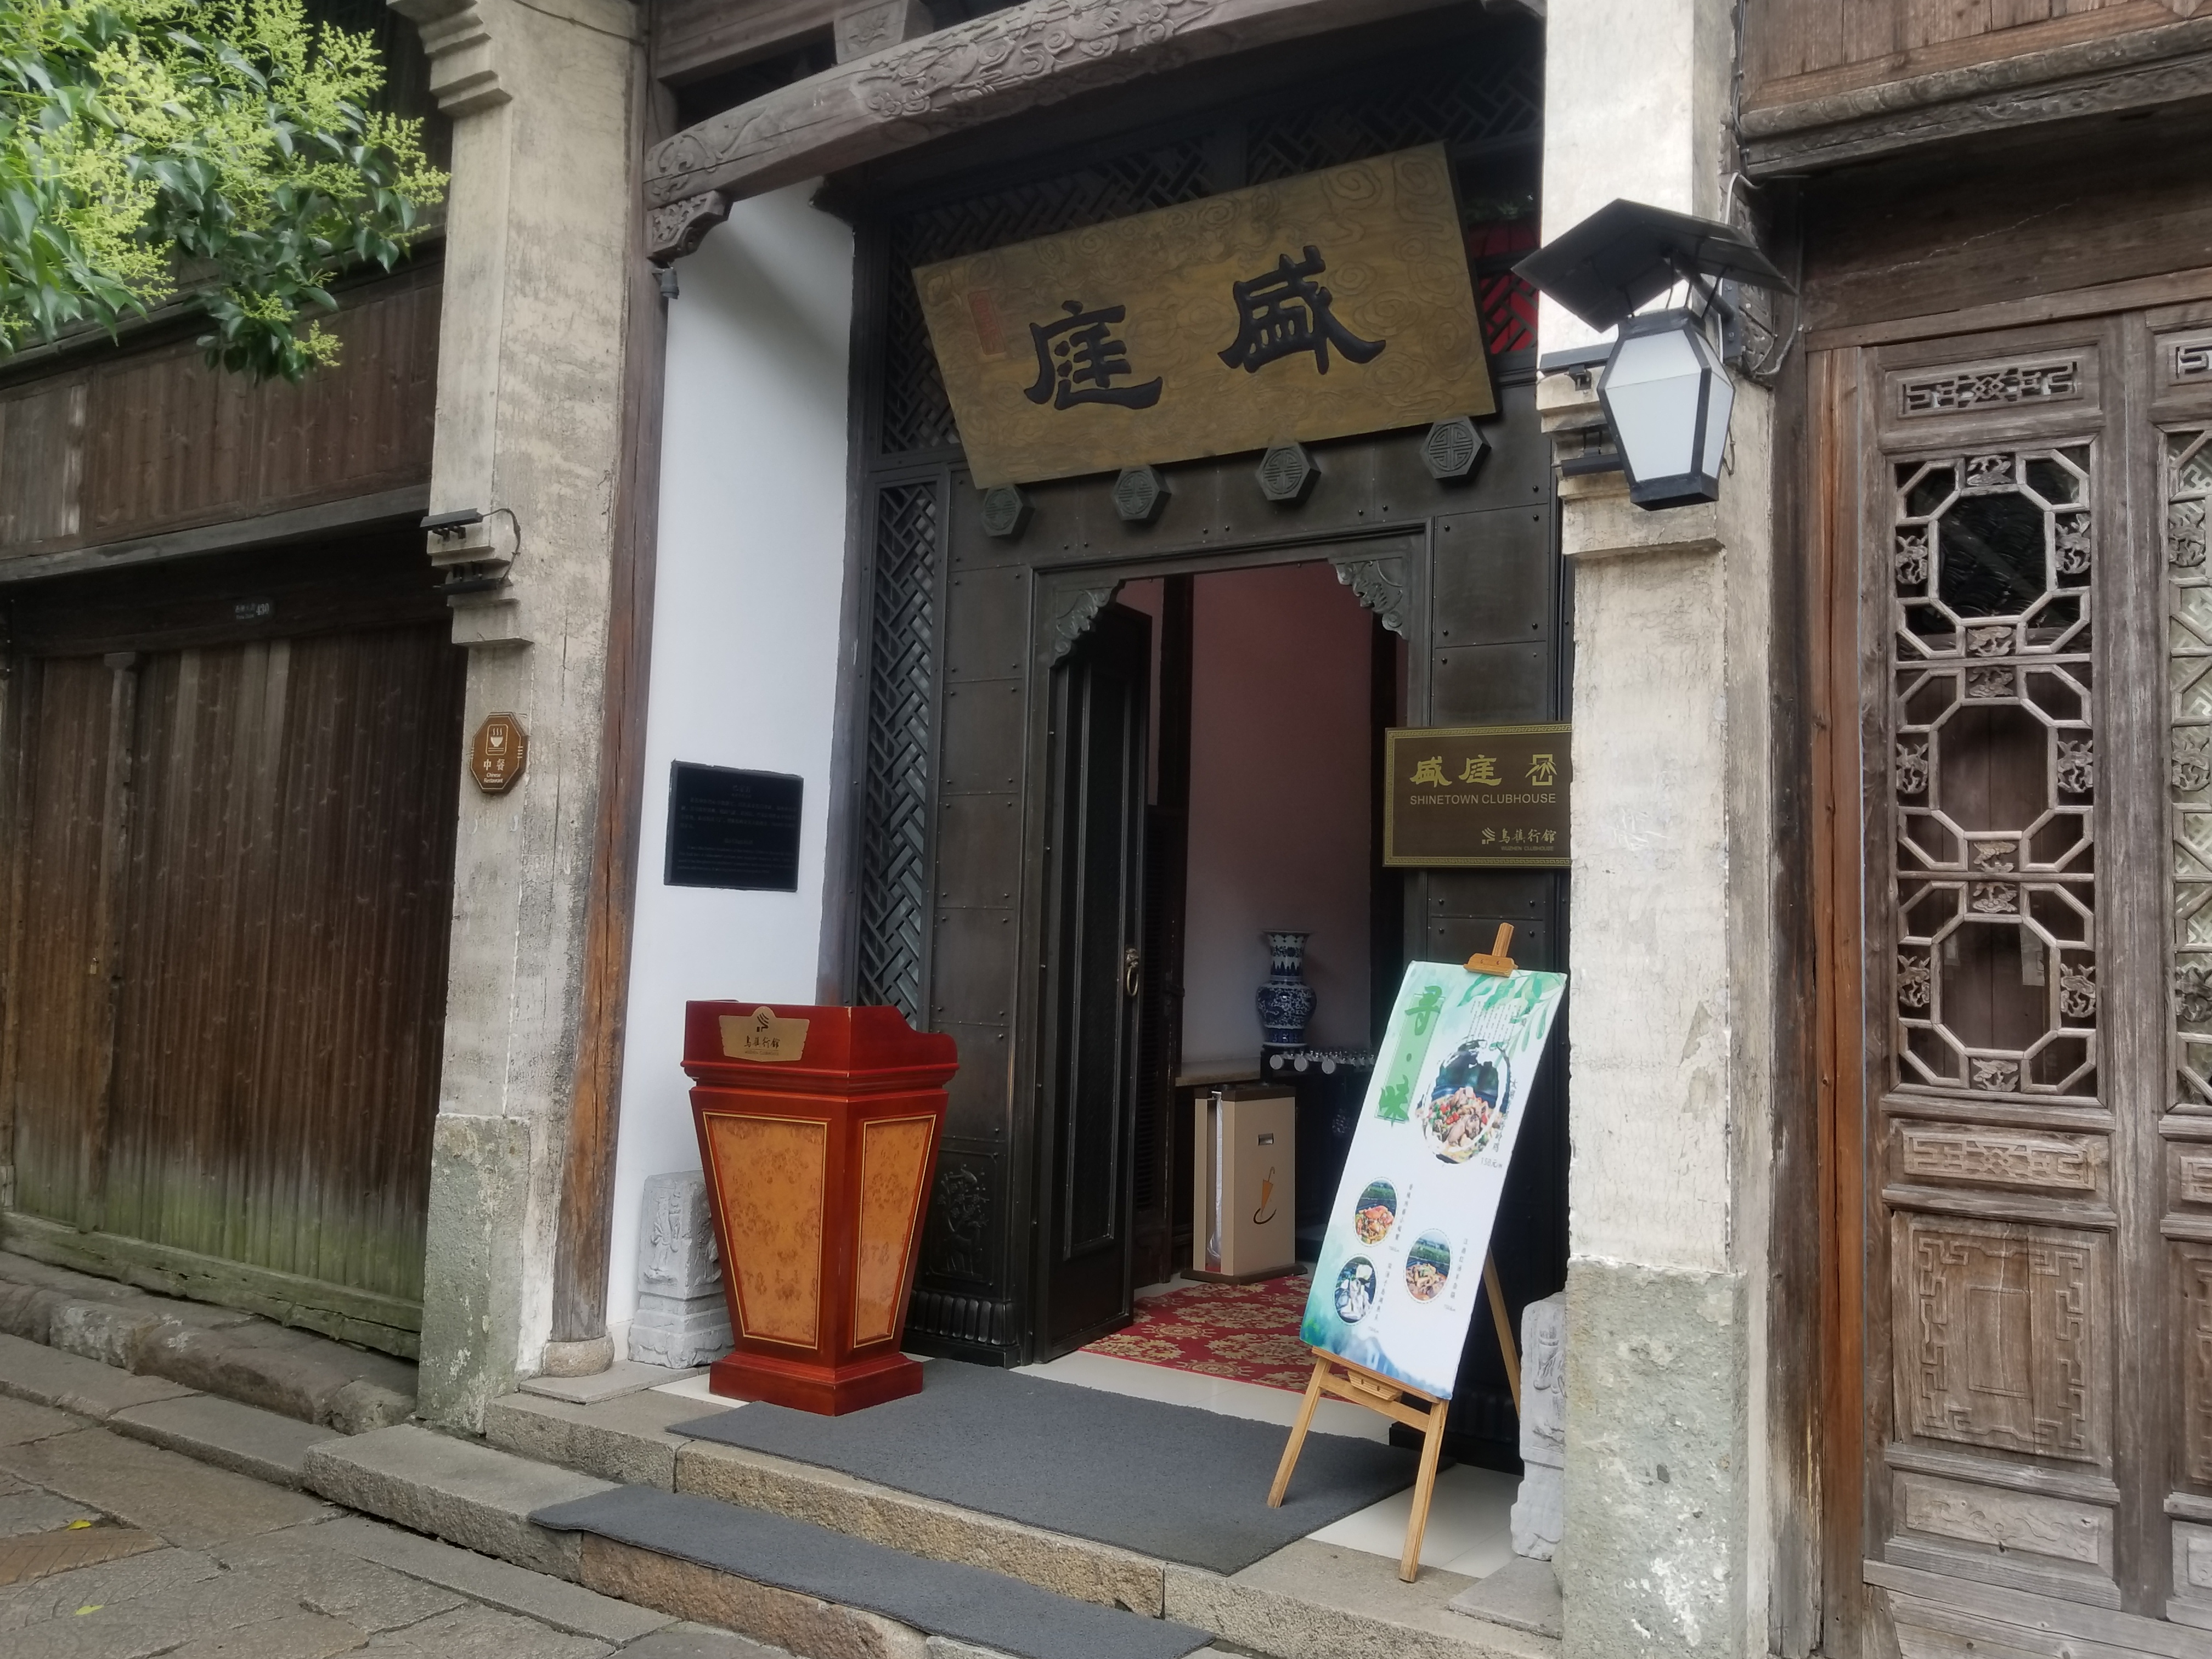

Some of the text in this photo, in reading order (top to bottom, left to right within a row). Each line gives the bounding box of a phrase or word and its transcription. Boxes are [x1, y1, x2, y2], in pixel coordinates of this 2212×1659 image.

[256, 603, 269, 616] 430
[483, 758, 505, 771] 中餐
[1409, 754, 1502, 788] 盛庭
[1410, 793, 1556, 805] SHINETOWN CLUBHOUSE
